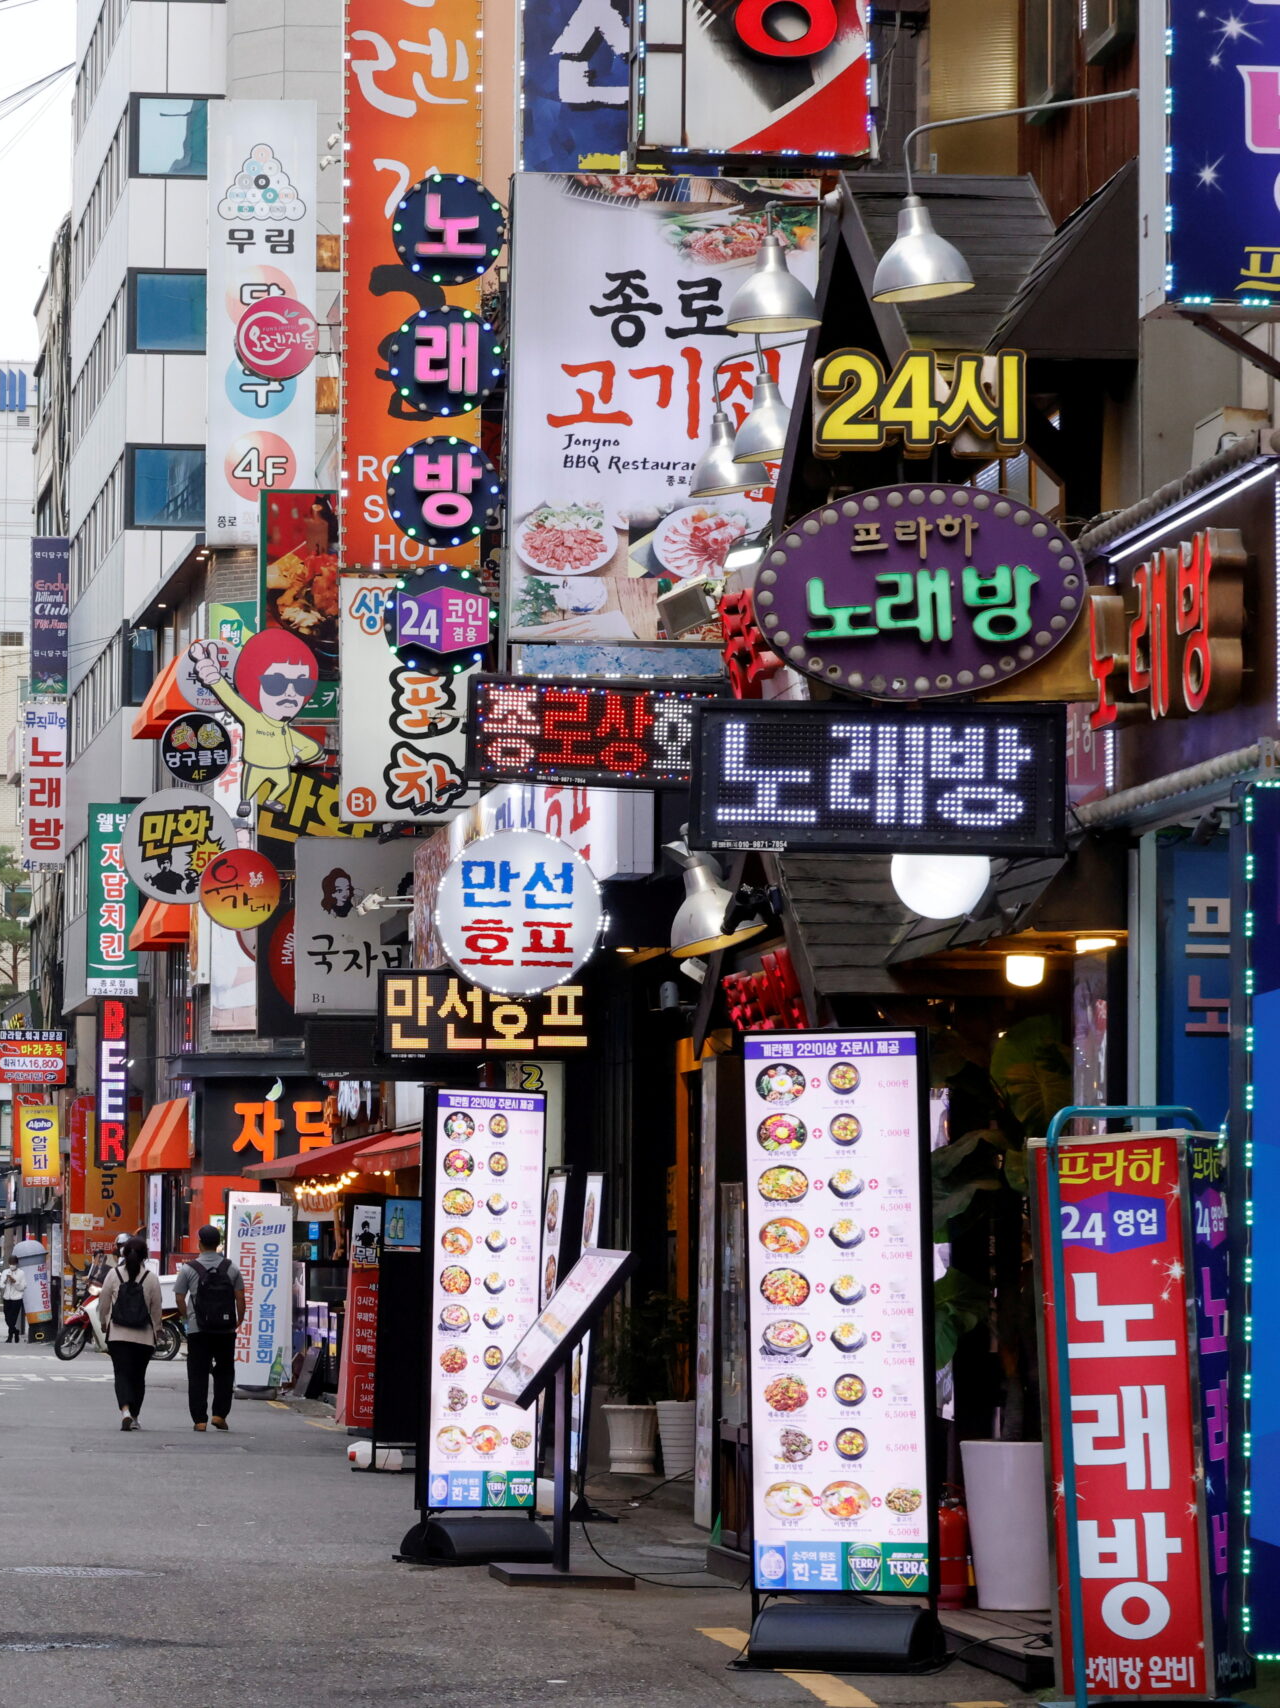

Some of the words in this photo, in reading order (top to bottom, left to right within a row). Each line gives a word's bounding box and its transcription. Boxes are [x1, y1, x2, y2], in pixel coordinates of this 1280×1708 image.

[226, 228, 295, 254] 무림
[590, 268, 739, 349] 종로
[248, 317, 317, 353] 오렌지룸
[413, 192, 487, 530] 노래방
[817, 350, 1024, 447] 24시
[562, 433, 621, 454] Jongno
[231, 447, 288, 488] 4F
[562, 454, 601, 474] BBQ
[849, 514, 979, 560] 프라하
[35, 591, 64, 603] Billiards
[35, 603, 68, 616] Club
[804, 563, 1040, 643] 노래방
[400, 599, 440, 644] 24
[445, 598, 483, 626] 코인
[452, 626, 478, 643] 겸용
[1089, 527, 1213, 731] 노래방
[386, 668, 464, 813] 포차
[165, 751, 229, 768] 당구클럽
[191, 769, 207, 781] 4F
[716, 723, 1031, 827] 노래방
[28, 736, 64, 851] 노래방
[350, 791, 374, 812] B1
[141, 807, 212, 858] 만화
[23, 859, 37, 871] 4F
[99, 843, 128, 962] 자담치킨
[460, 860, 575, 909] 만선
[459, 918, 575, 968] 호프
[92, 988, 134, 996] 734-7788
[312, 993, 326, 1004] B1
[385, 975, 588, 1050] 만선호프
[20, 1043, 65, 1056] 마라중독
[760, 1043, 794, 1057] 계란찜
[796, 1042, 838, 1057] 2인이상
[840, 1041, 874, 1056] 주문시
[877, 1040, 900, 1055] 제공
[101, 1000, 126, 1162] BEER
[470, 1096, 497, 1110] 2인이상
[498, 1097, 519, 1111] 주문시
[27, 1119, 52, 1129] Alpha
[232, 1099, 334, 1163] 자담
[1057, 1146, 1166, 1187] 프라하
[237, 1223, 287, 1239] 여름별미
[1060, 1205, 1107, 1246] 24
[1113, 1208, 1158, 1237] 영업
[1066, 1271, 1183, 1640] 노래방
[509, 1484, 533, 1496] TERRA
[850, 1558, 880, 1570] TERRA
[887, 1560, 929, 1577] TERRA
[1147, 1655, 1196, 1689] 완비
